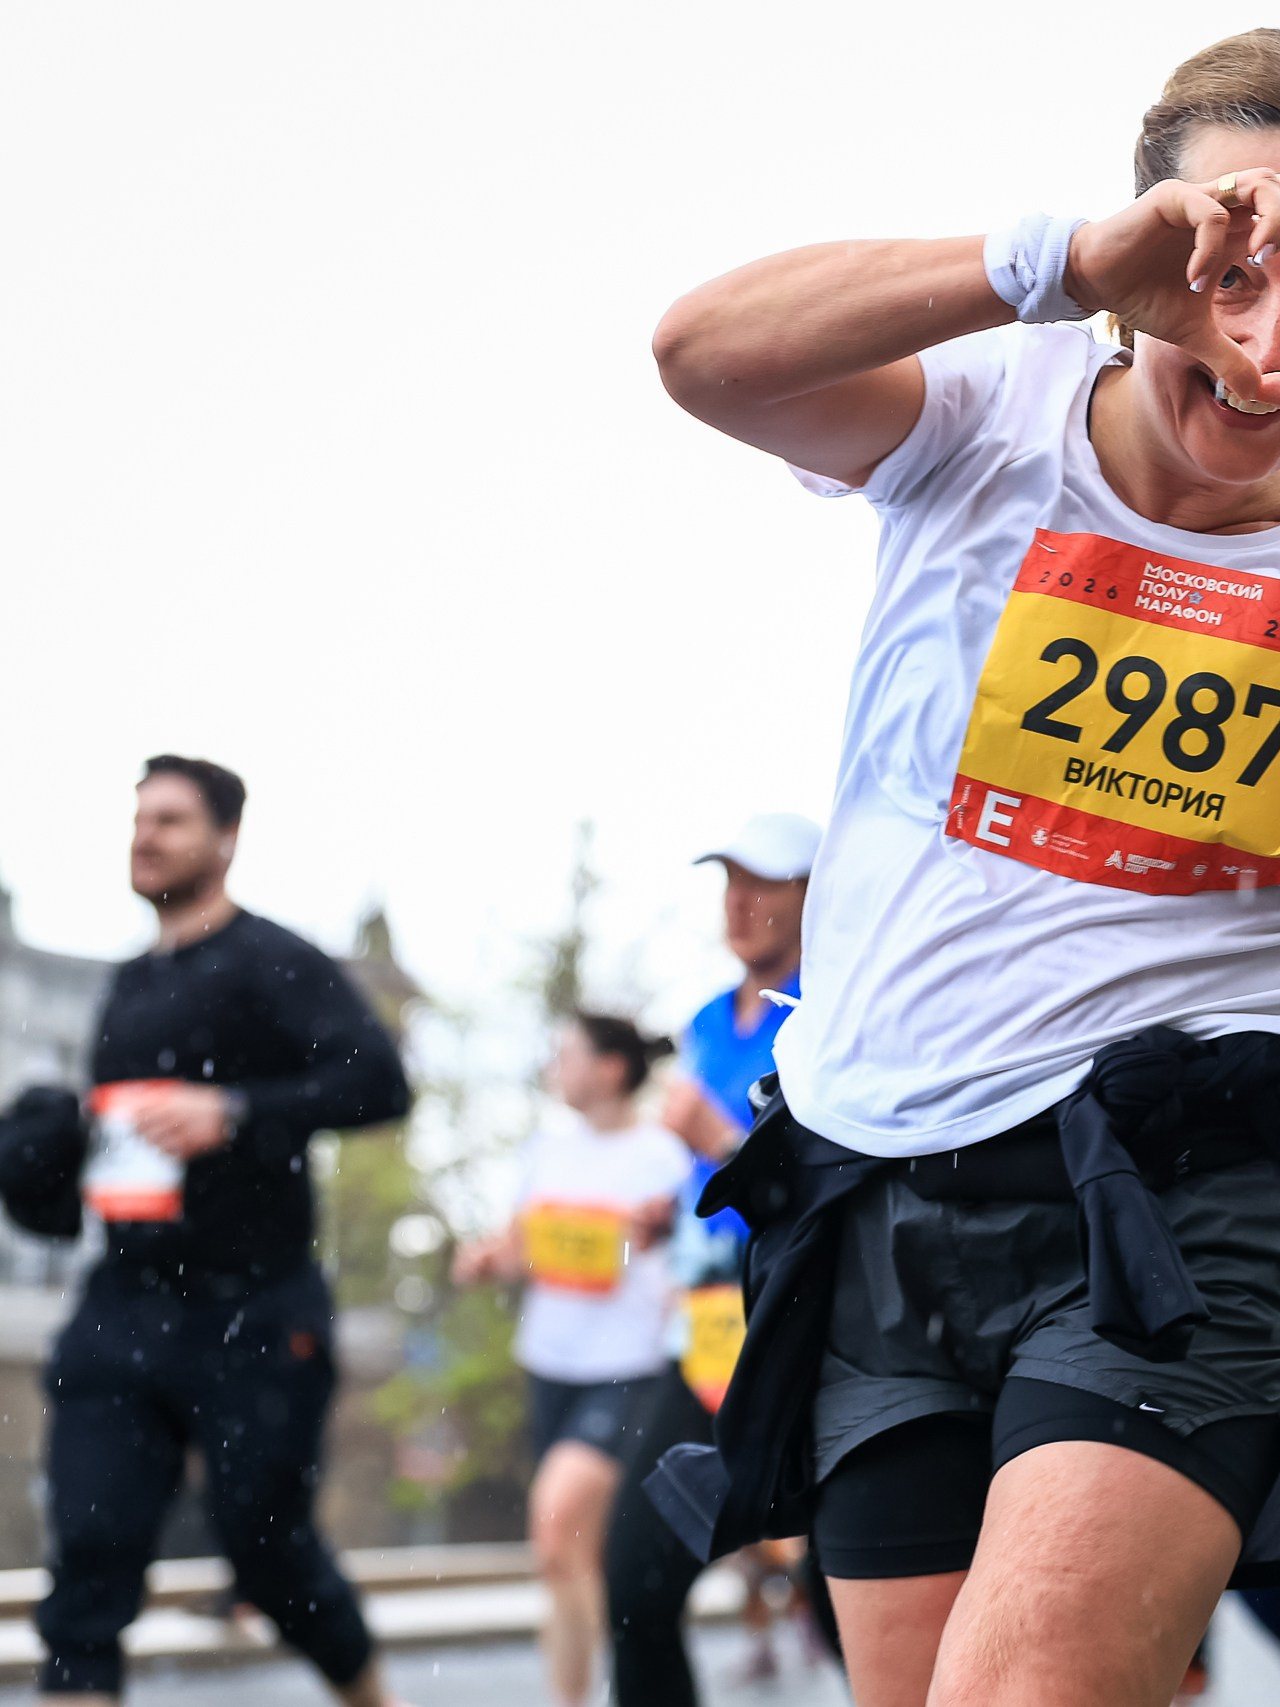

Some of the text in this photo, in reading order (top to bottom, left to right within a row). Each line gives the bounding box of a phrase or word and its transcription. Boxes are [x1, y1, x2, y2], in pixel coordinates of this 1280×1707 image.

[1139, 579, 1190, 601] ПОЛУ
[1143, 562, 1264, 601] МОСКОВСКИЙ
[1134, 595, 1223, 626] МАРАФОН
[1063, 756, 1226, 822] ВИКТОРИЯ
